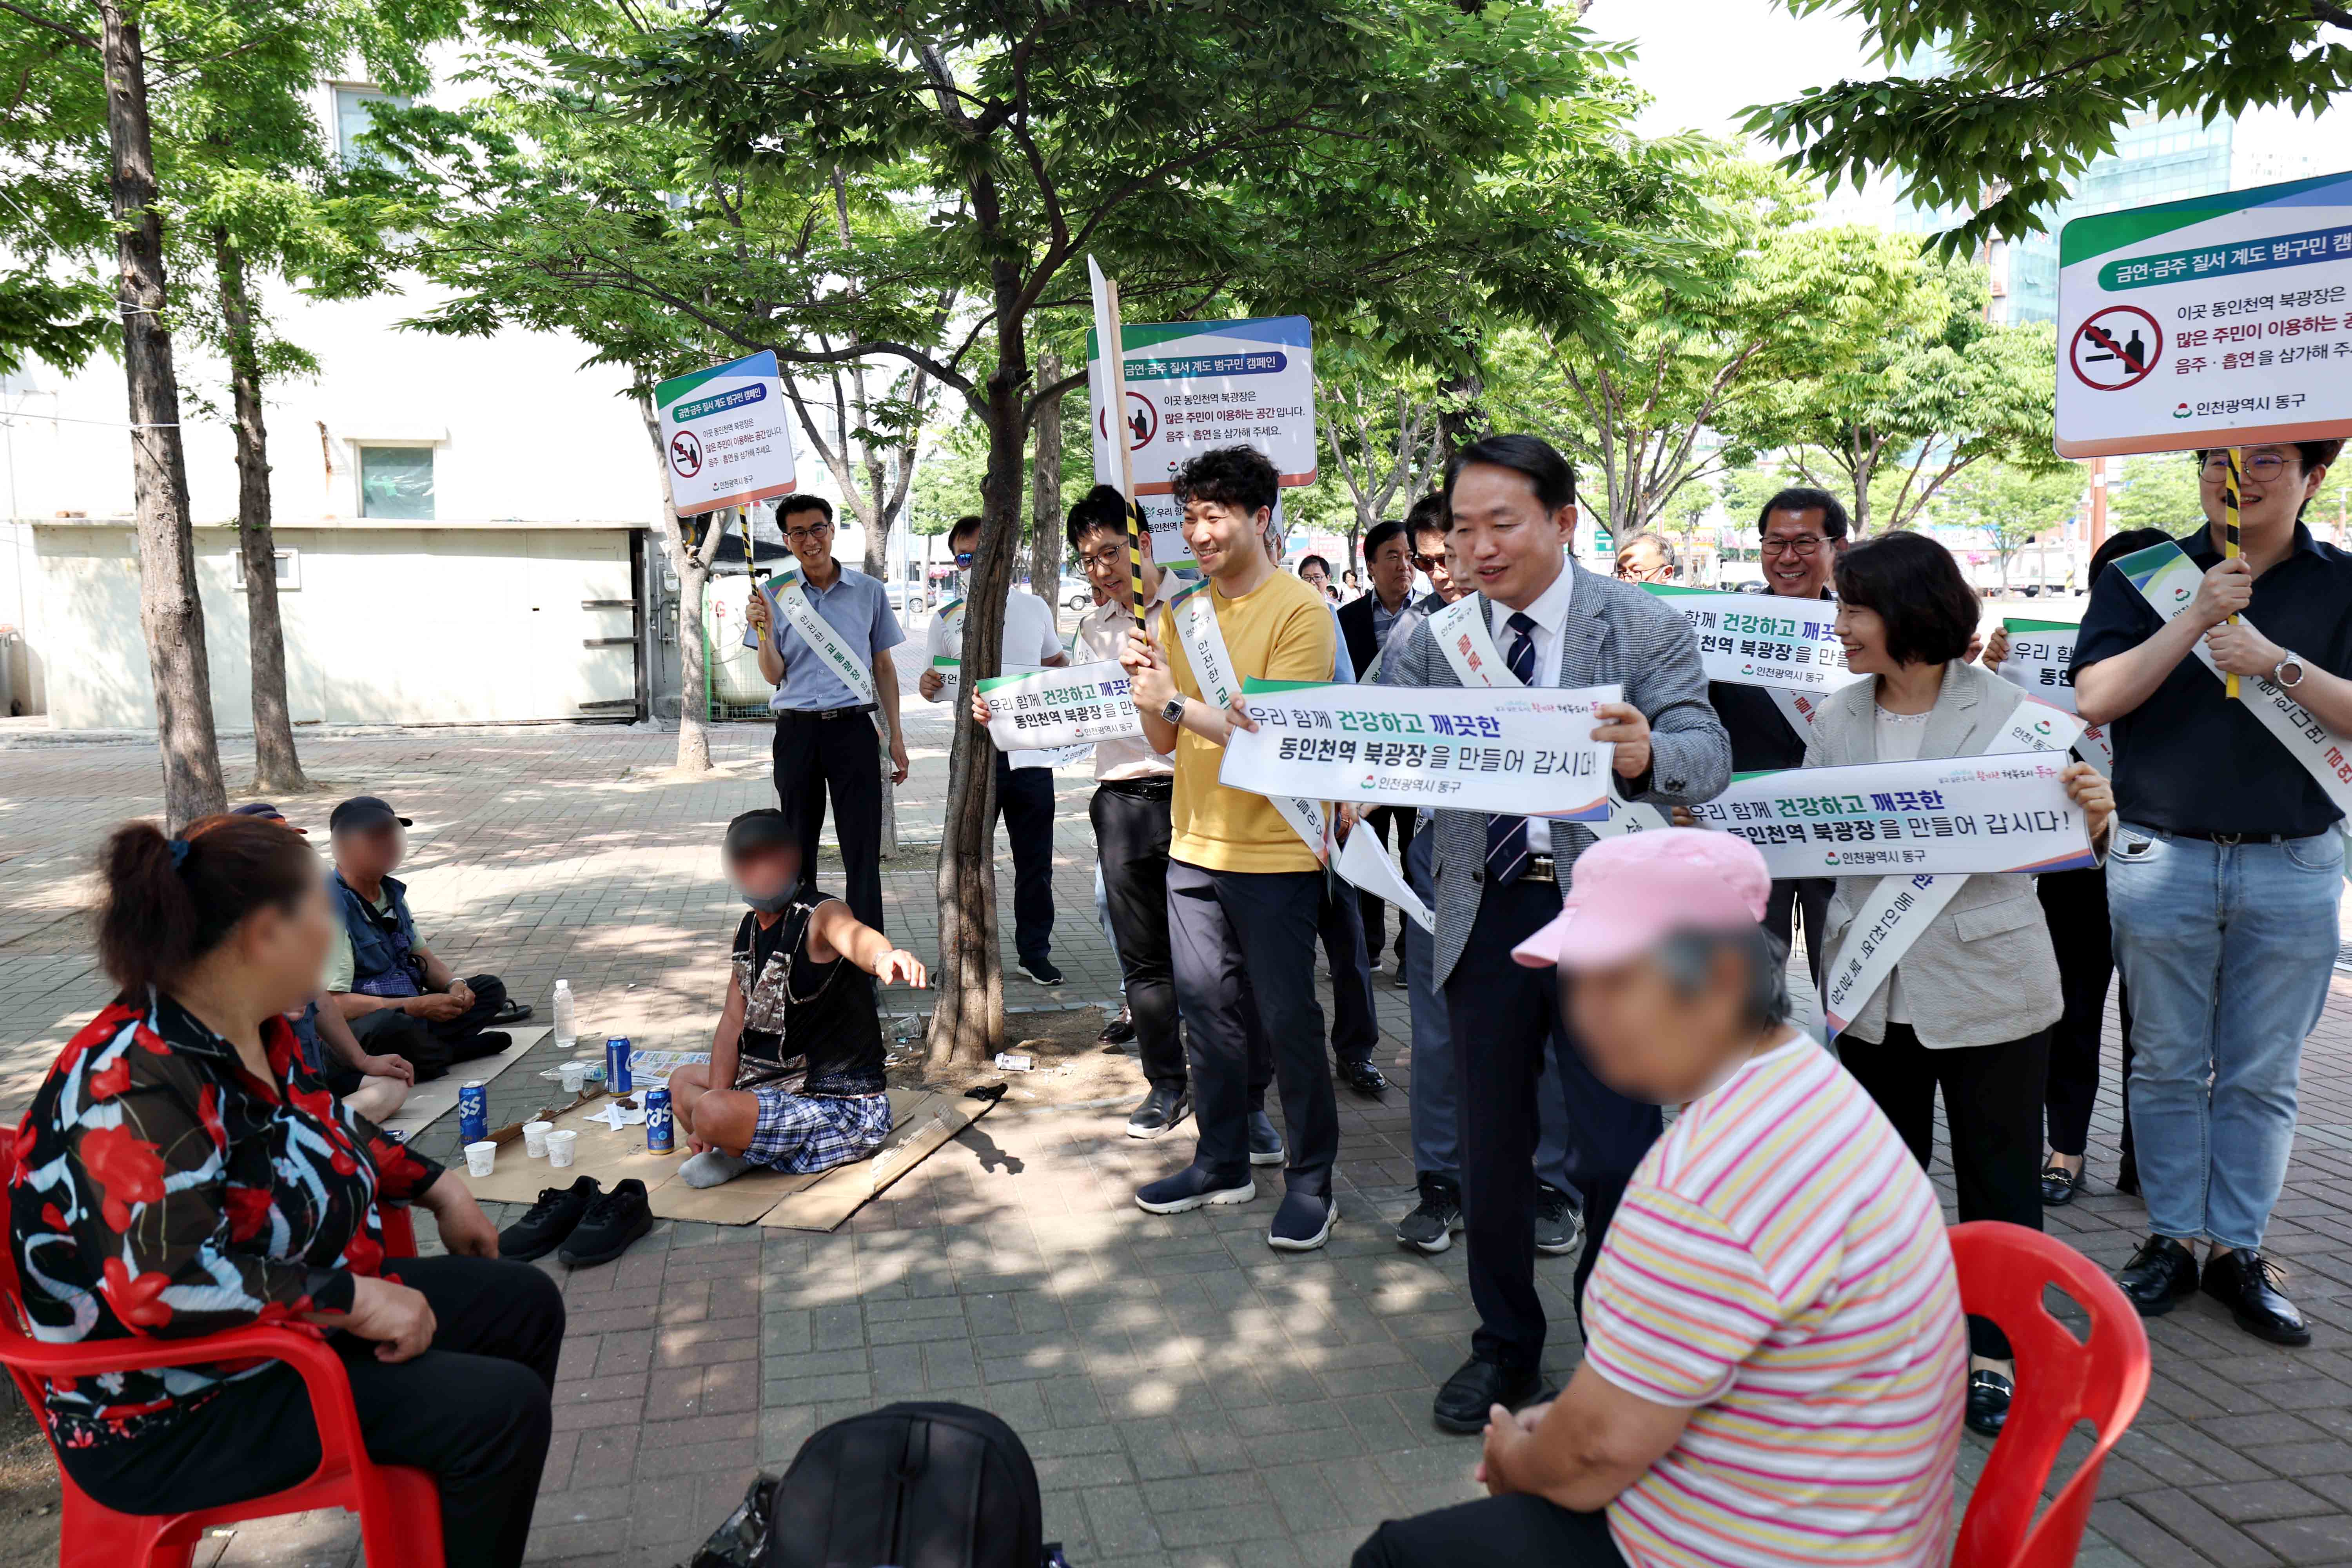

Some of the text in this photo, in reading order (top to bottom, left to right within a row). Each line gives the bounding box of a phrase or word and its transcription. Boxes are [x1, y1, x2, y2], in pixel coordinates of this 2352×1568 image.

[2192, 251, 2226, 272] 질서
[2230, 247, 2266, 267] 계도
[2272, 236, 2327, 261] 범구민
[2178, 286, 2346, 321] 이곳 동인천역 북광장은
[2176, 329, 2208, 349] 많은
[2212, 323, 2262, 344] 주민이
[2268, 315, 2338, 338] 이용하는
[1170, 361, 1189, 374] 질서
[1192, 359, 1211, 372] 계도
[1214, 358, 1244, 371] 범구민
[1246, 356, 1276, 369] 캠페인
[2174, 358, 2207, 375] 음주
[2278, 343, 2329, 364] 삼가해
[702, 402, 714, 412] 질서
[715, 398, 726, 408] 계도
[726, 394, 743, 405] 범구민
[744, 387, 761, 401] 캠페인
[1164, 391, 1256, 406] 이곳 동인천역 북광장은
[2196, 393, 2306, 416] 인천광역시 동구
[703, 418, 754, 438] 이곳 동인천역 북광장은
[1165, 413, 1183, 425] 많은
[1186, 410, 1214, 423] 주민이
[1216, 409, 1254, 422] 이용하는
[706, 443, 716, 453] 많은
[717, 439, 733, 450] 주민이
[734, 434, 754, 446] 이용하는
[1165, 430, 1185, 442] 음주
[1224, 427, 1250, 439] 삼가해
[1253, 426, 1281, 437] 주세요.
[708, 458, 719, 468] 음주
[740, 449, 755, 459] 삼가해
[755, 445, 772, 457] 주세요.
[720, 475, 753, 490] 인천광역시 동구
[1157, 507, 1184, 517] 우리 함
[1685, 610, 1837, 643] 함께 건강하고 깨끗
[800, 615, 825, 642] 안전한
[825, 642, 860, 680] 교통광장
[1700, 635, 1848, 668] 천역 북광장을 만들
[2015, 642, 2073, 662] 우리 함
[1198, 640, 1220, 683] 안전한
[1757, 666, 1824, 683] 인천광역시 동구
[989, 697, 1014, 712] 우리
[1015, 694, 1042, 709] 함께
[1042, 684, 1097, 706] 건강하고
[1014, 712, 1062, 729] 동인천역
[1065, 703, 1117, 723] 북광장을
[1084, 722, 1133, 735] 인천광역시 동구
[1250, 707, 1501, 738] 우리 함께 건강하고 깨끗한
[2012, 726, 2034, 744] 인천
[1279, 738, 1356, 763] 동인천역
[1364, 742, 1450, 769] 북광장을
[1459, 747, 1524, 773] 만들어
[2323, 746, 2352, 784] 금연
[2034, 766, 2057, 778] 동구
[1379, 777, 1461, 793] 인천광역시 동구
[1690, 789, 1945, 821] 우리 함께 건강하고 깨끗한
[1813, 817, 1901, 842] 북광장을
[1907, 814, 1977, 838] 만들어
[1984, 811, 2070, 835] 갑시다!
[1842, 850, 1926, 864] 인천광역시 동구
[1861, 891, 1915, 960] 동인천역
[1831, 958, 1863, 1005] 북광장
